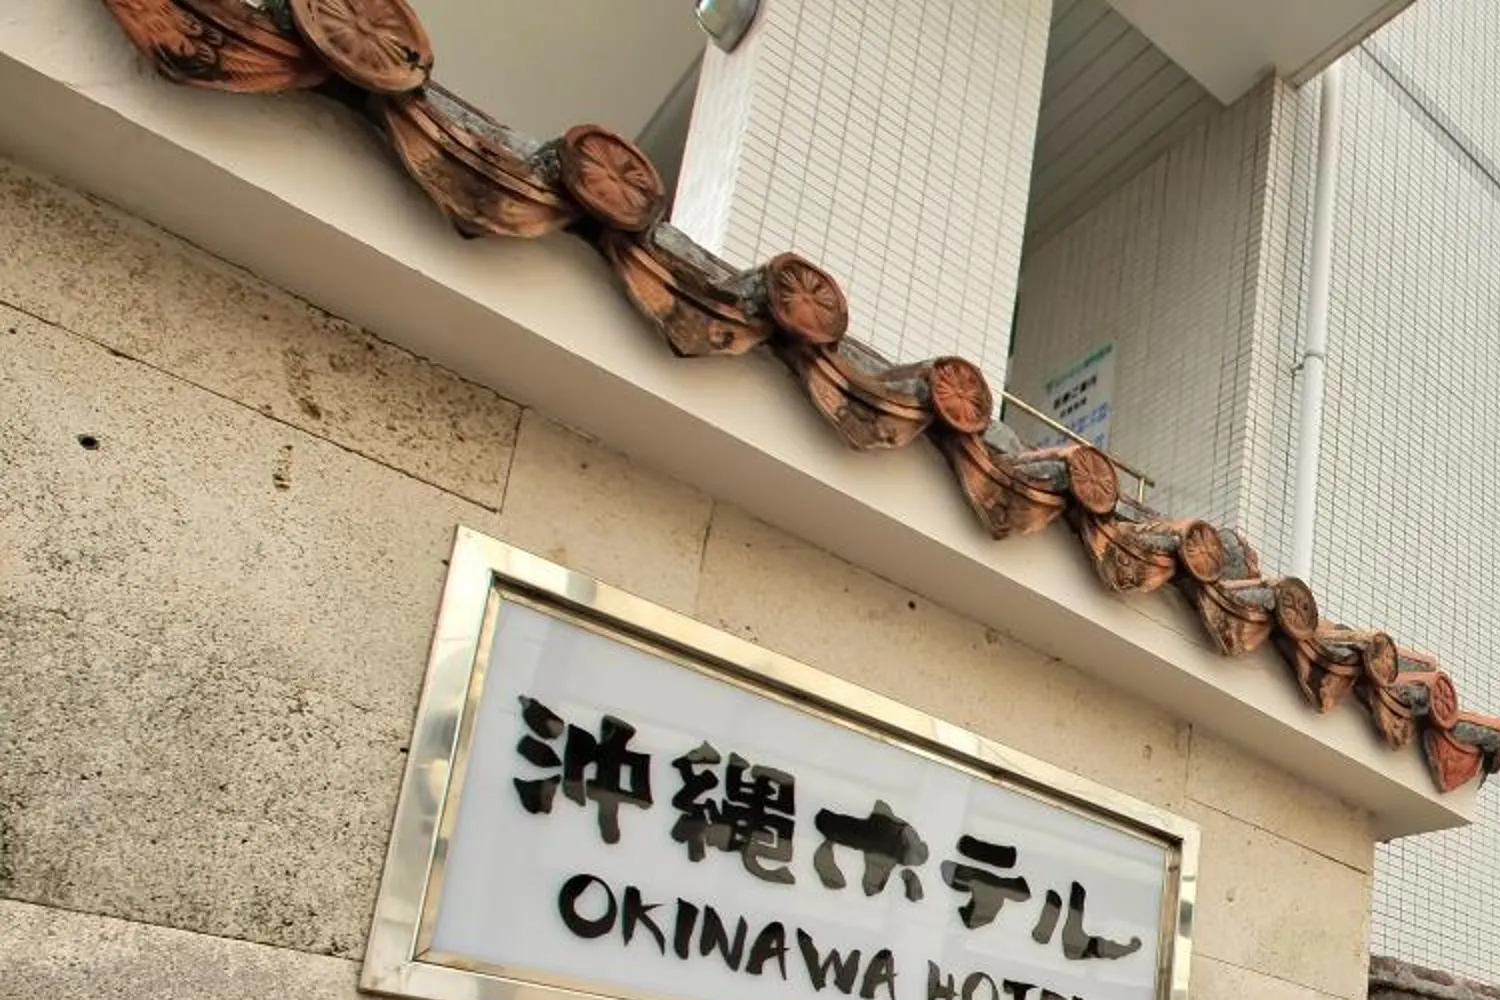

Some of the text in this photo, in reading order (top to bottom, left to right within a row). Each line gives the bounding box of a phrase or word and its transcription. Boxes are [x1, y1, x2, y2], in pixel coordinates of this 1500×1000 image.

[513, 695, 1142, 961] 沖縄ホテル
